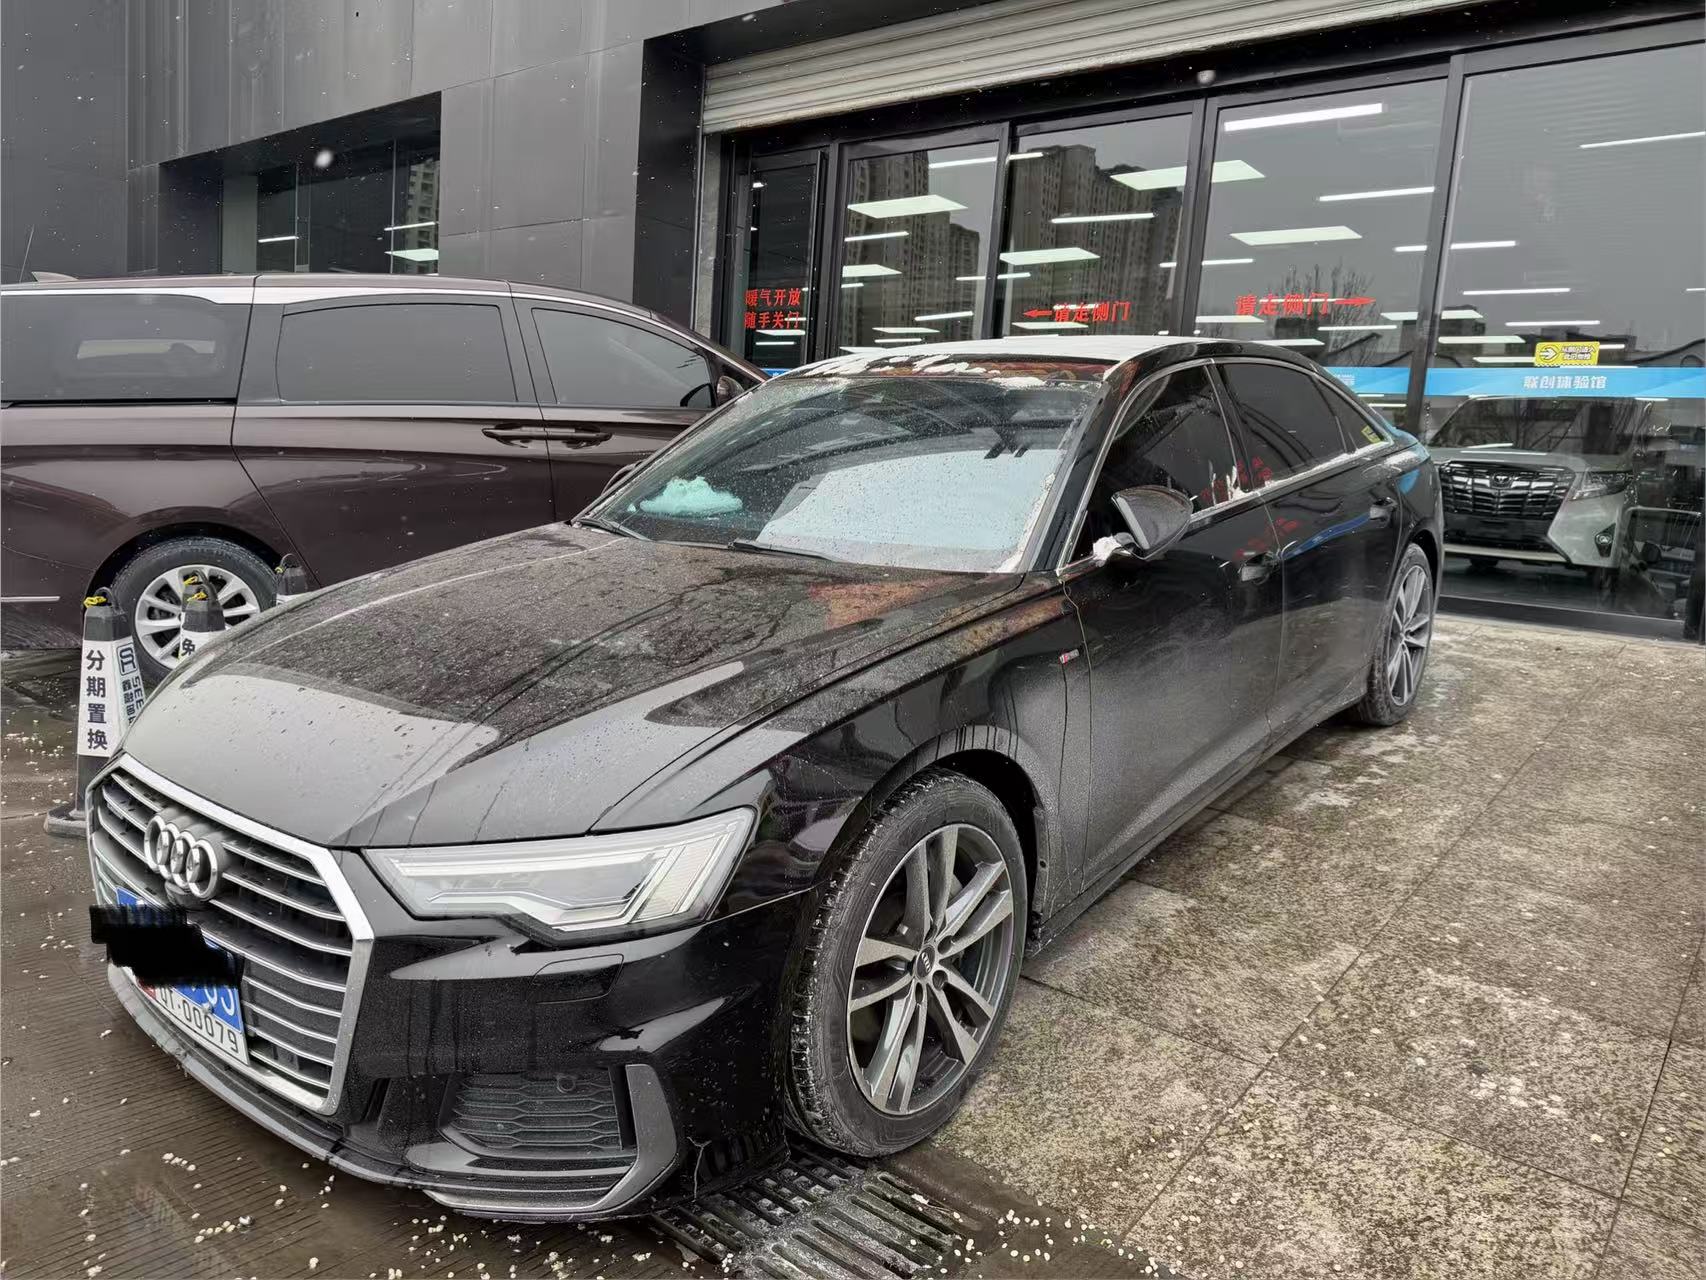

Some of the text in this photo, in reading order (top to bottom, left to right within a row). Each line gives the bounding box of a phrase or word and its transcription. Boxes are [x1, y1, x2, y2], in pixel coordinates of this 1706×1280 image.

[745, 288, 801, 306] 暖气开放
[1236, 292, 1329, 316] 请走侧门
[744, 311, 800, 329] 随手关门
[1054, 301, 1131, 322] 请走侧门
[1523, 375, 1607, 389] 联创体验馆
[86, 649, 107, 750] 分期置换
